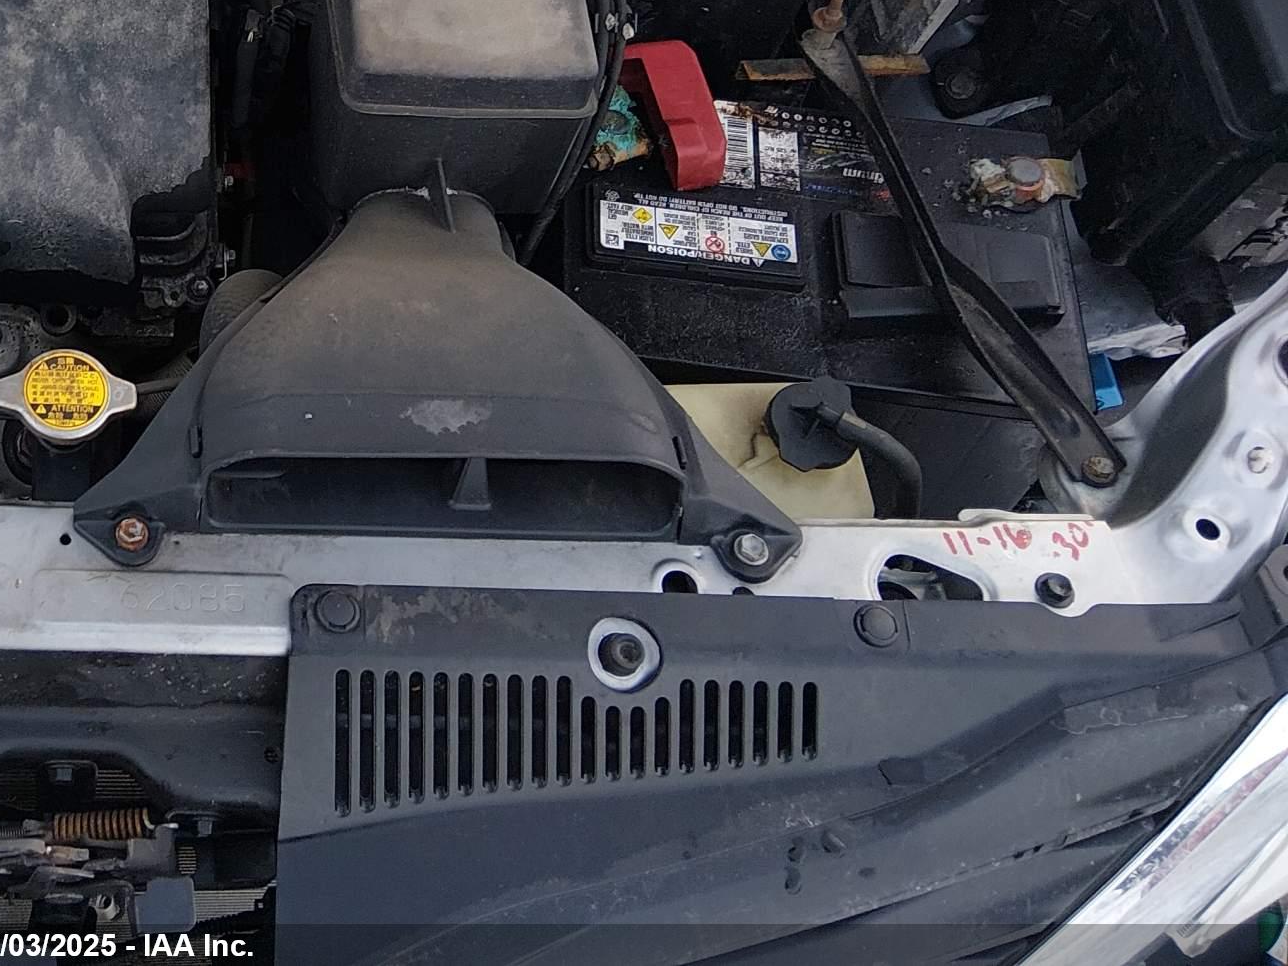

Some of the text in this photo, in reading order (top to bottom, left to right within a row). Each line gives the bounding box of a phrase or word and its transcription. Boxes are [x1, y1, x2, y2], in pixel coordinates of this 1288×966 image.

[842, 167, 884, 184] tinum
[50, 363, 89, 371] CAUTION
[51, 404, 94, 413] ATTENTION
